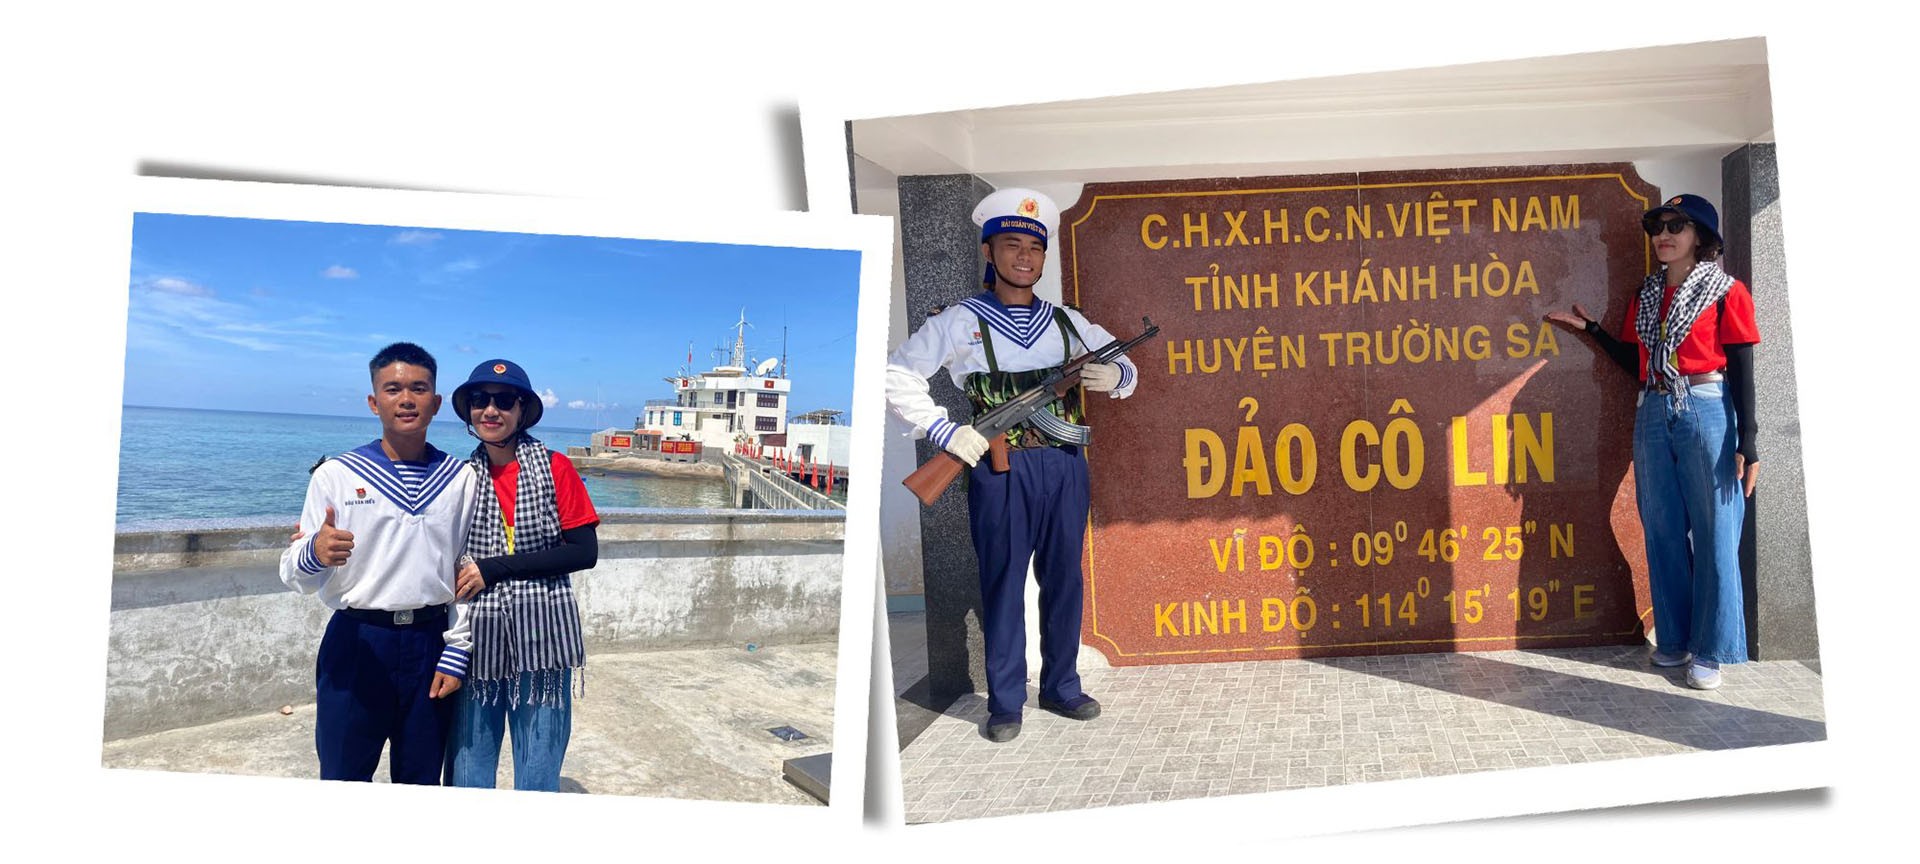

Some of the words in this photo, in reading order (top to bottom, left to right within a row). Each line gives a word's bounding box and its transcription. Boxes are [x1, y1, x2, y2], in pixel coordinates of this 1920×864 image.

[1491, 194, 1581, 233] NAM
[1185, 262, 1279, 312] TỈNH
[1295, 258, 1437, 307] KHÁNH
[1453, 252, 1541, 299] HÒA
[1167, 326, 1306, 378] HUYỆN
[1320, 318, 1492, 367] TRƯỜNG
[1506, 321, 1560, 359] SA
[1182, 397, 1318, 499] ĐẢO
[1339, 398, 1425, 493] CÔ
[1452, 411, 1556, 487] LIN
[1208, 529, 1246, 573] VĨ
[1258, 524, 1316, 577] ĐỘ
[1549, 522, 1575, 559] N
[1153, 602, 1248, 638] KINH
[1260, 587, 1317, 638] ĐỘ
[1573, 584, 1596, 620] E
